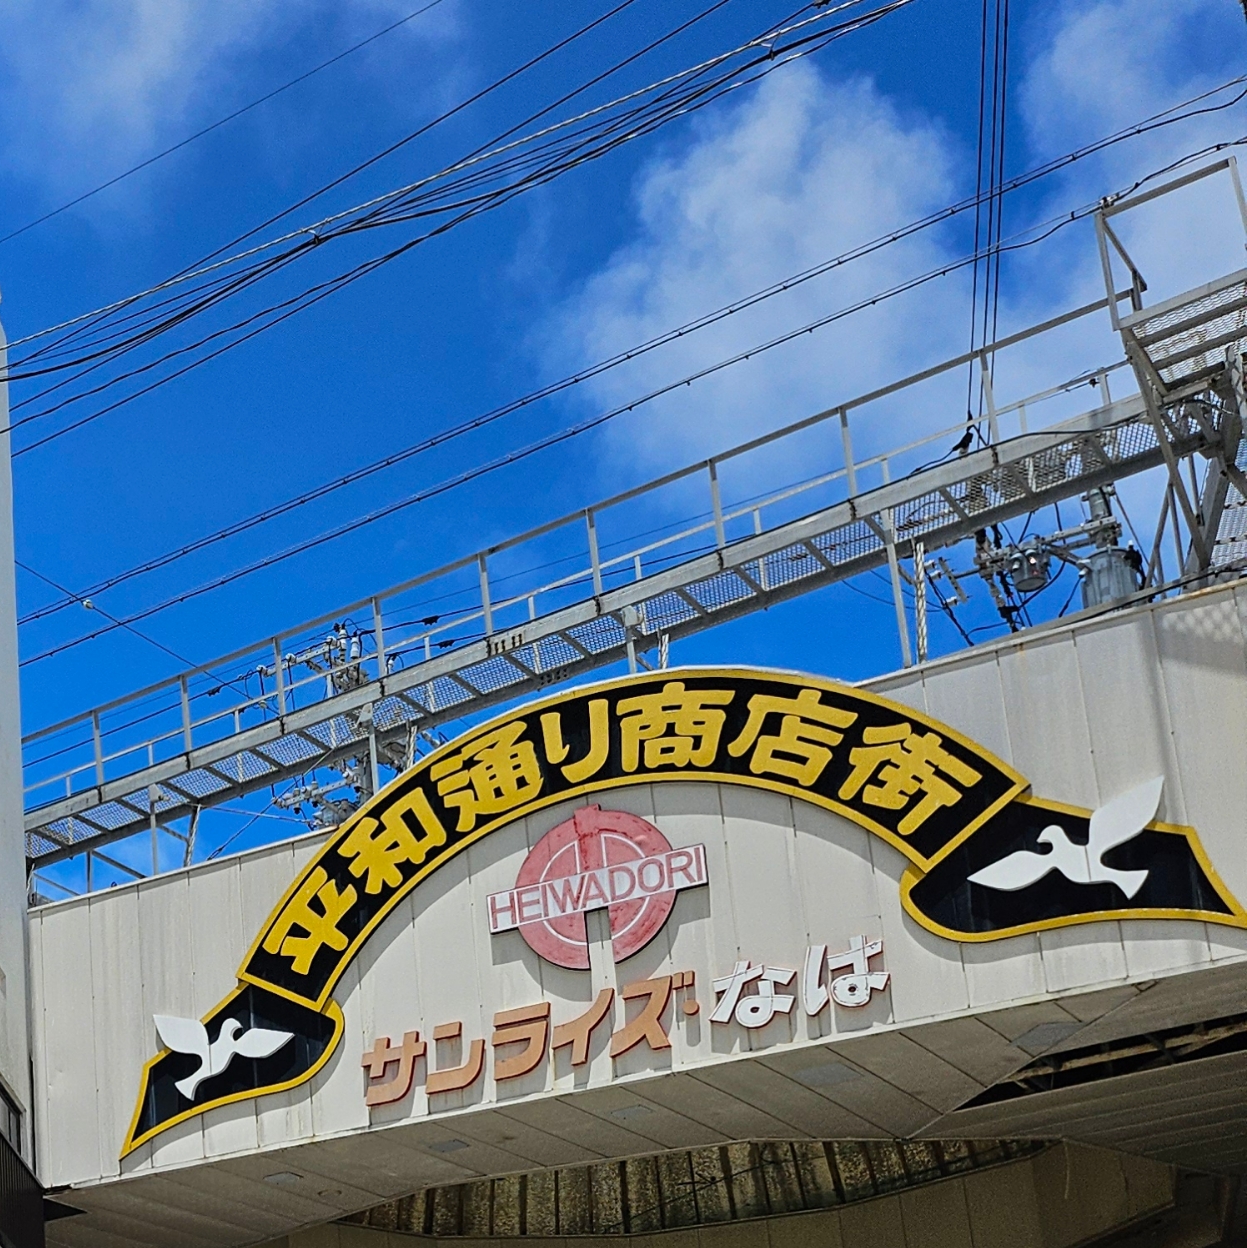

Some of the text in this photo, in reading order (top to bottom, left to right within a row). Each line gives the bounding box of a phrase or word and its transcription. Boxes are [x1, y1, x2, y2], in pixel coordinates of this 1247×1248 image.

[263, 682, 983, 975] 平和通り商店街
[490, 846, 704, 931] HEIWADORI
